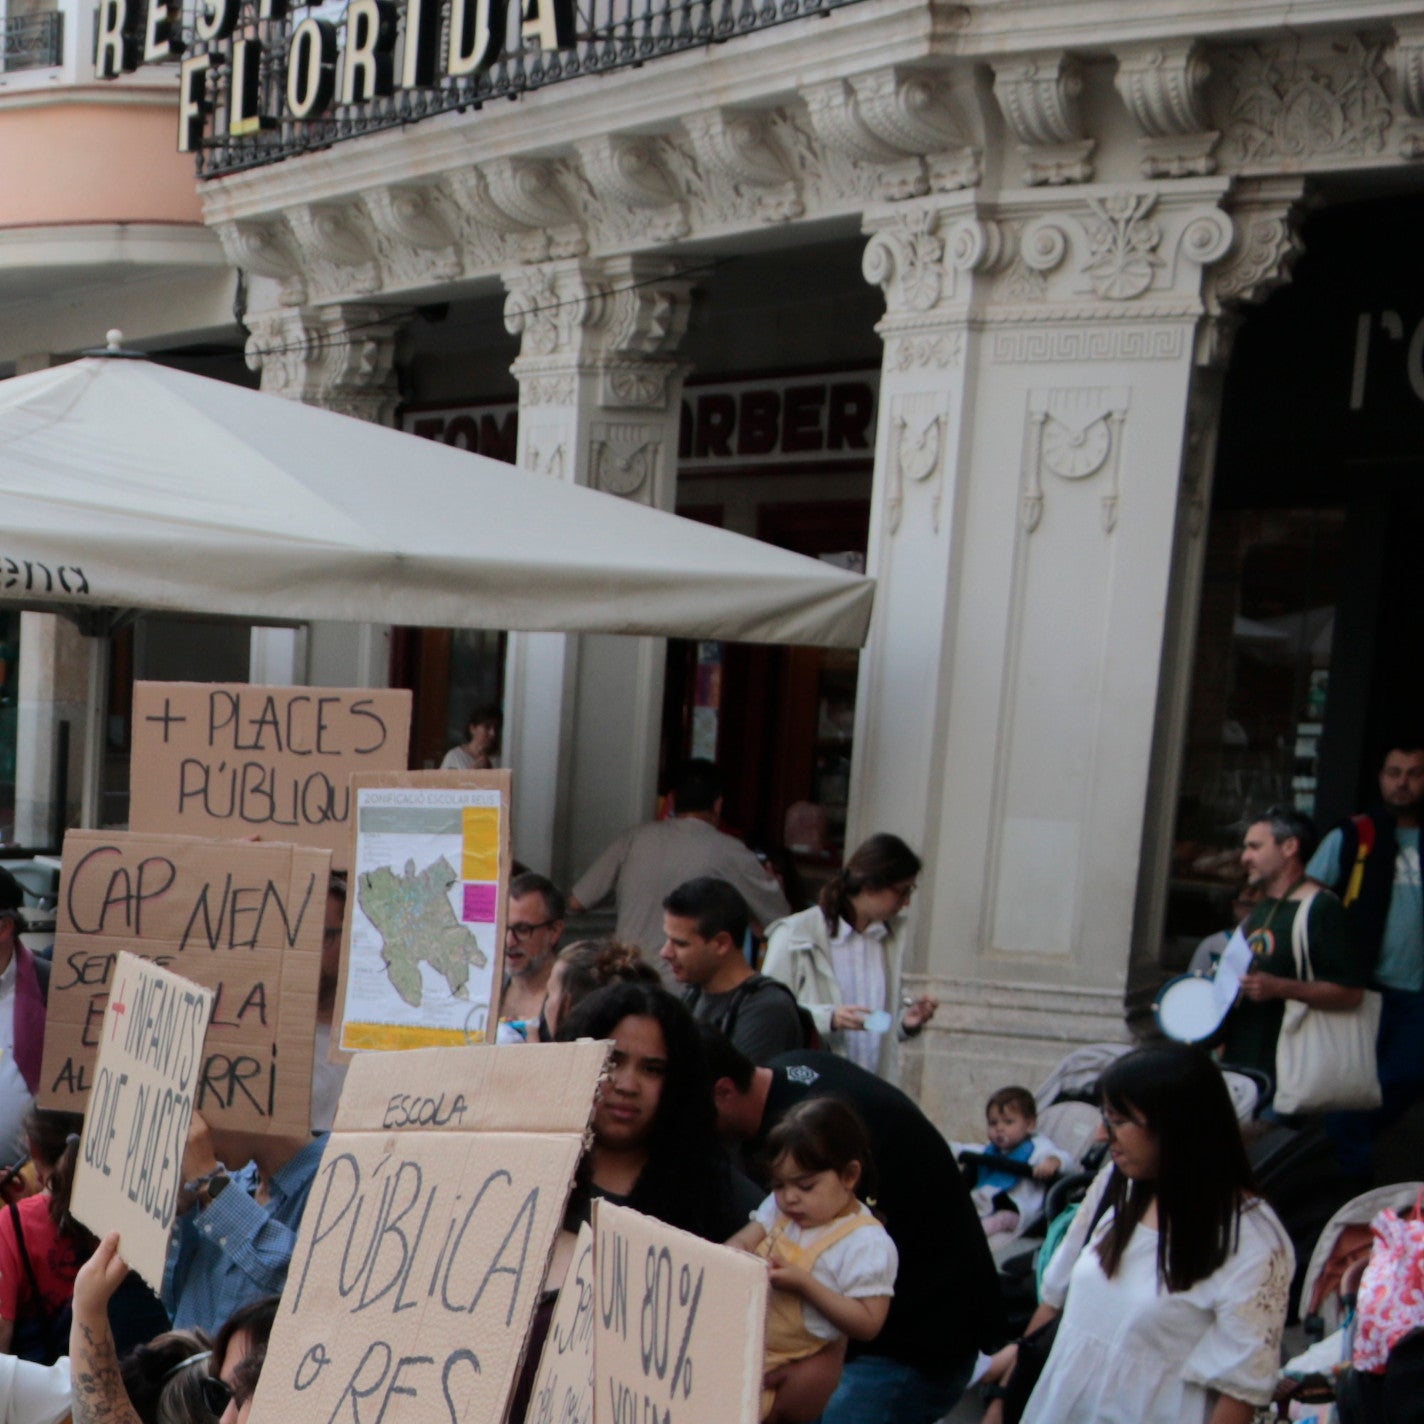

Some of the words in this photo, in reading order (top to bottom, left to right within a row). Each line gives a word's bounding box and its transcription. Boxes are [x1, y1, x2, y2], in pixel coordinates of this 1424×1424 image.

[209, 691, 388, 755] PLACES
[179, 758, 350, 826] PÚBLIQU
[67, 846, 176, 936] CAP
[179, 872, 316, 951] NEN
[84, 1066, 129, 1177] QUE
[382, 1093, 468, 1129] ESCOLA
[600, 1230, 629, 1342] UN
[639, 1244, 705, 1400] 80%
